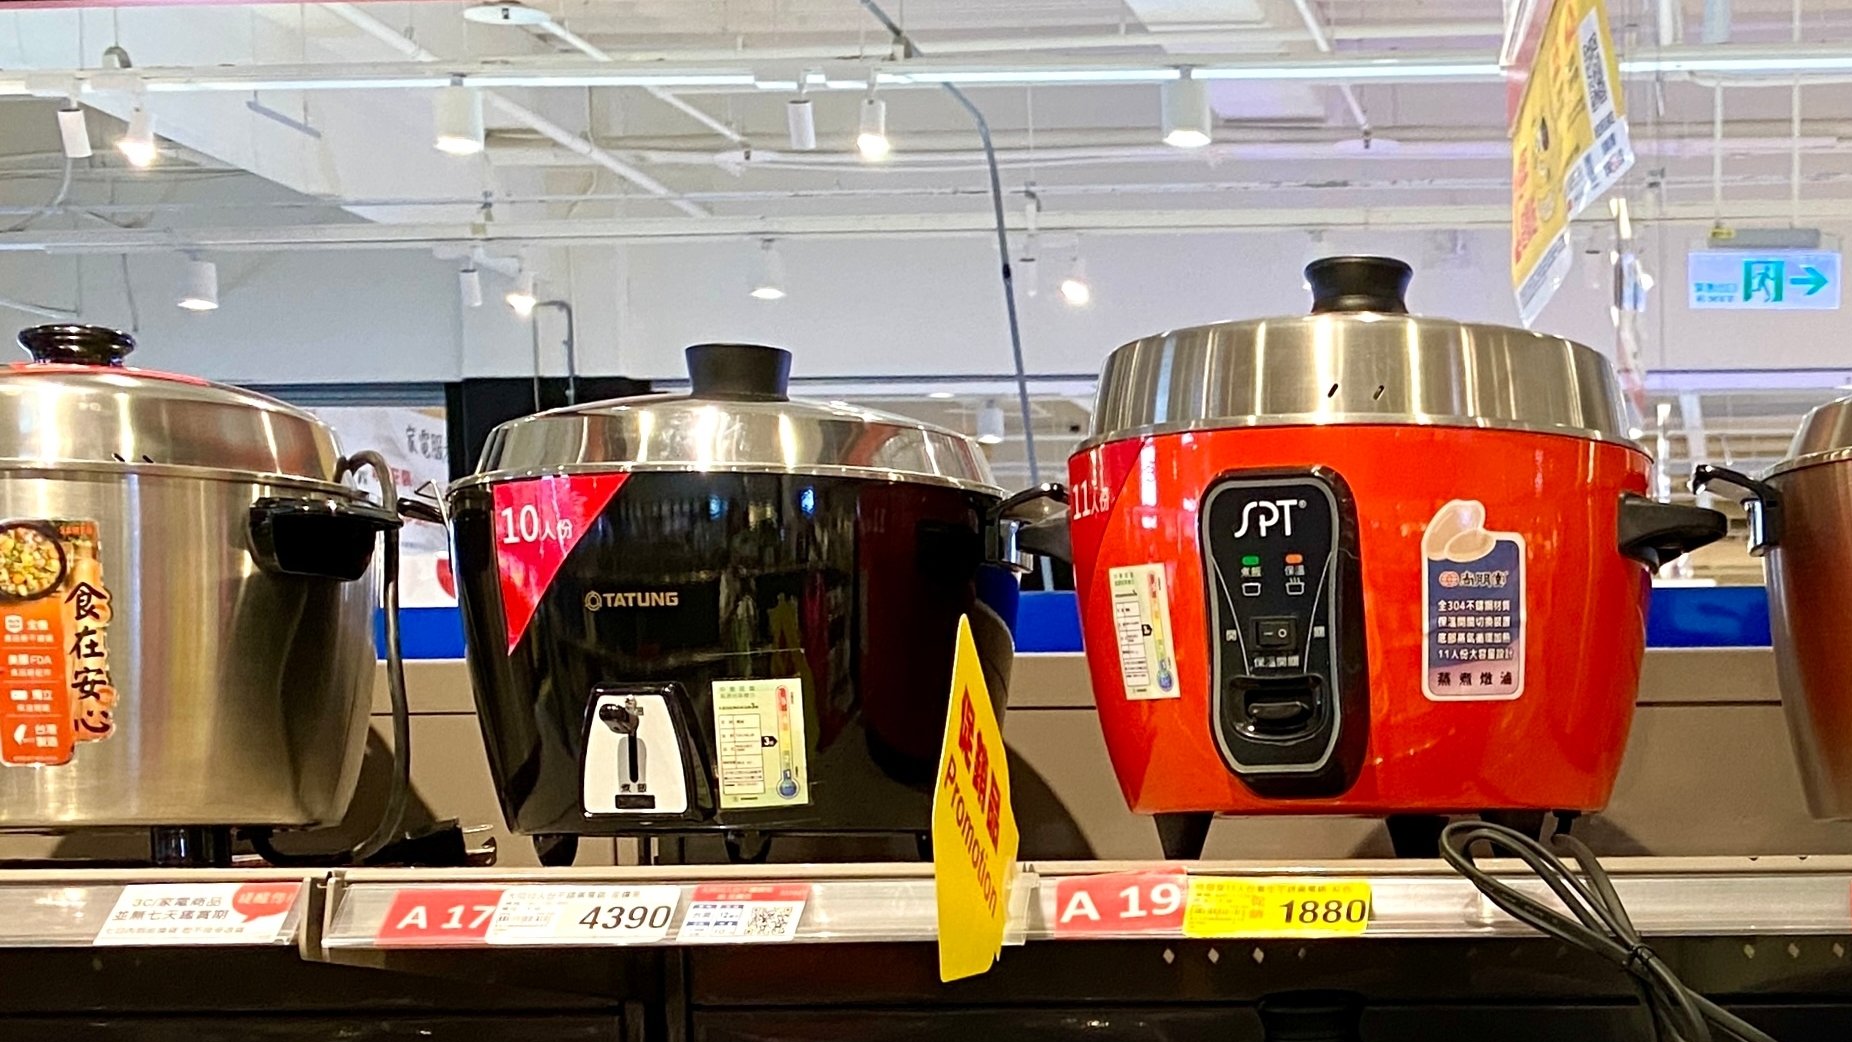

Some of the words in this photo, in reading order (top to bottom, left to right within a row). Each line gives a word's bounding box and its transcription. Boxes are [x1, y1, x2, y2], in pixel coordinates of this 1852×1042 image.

[1073, 480, 1110, 519] 11人份
[501, 503, 573, 544] 10人份
[603, 591, 679, 607] TATUNG
[65, 581, 112, 734] 食在安心
[944, 754, 996, 918] Promotion
[397, 905, 427, 929] A
[440, 905, 494, 929] 17
[579, 906, 671, 929] 4390
[1060, 891, 1100, 922] A
[1119, 884, 1181, 919] 19
[1280, 899, 1366, 923] 1880
